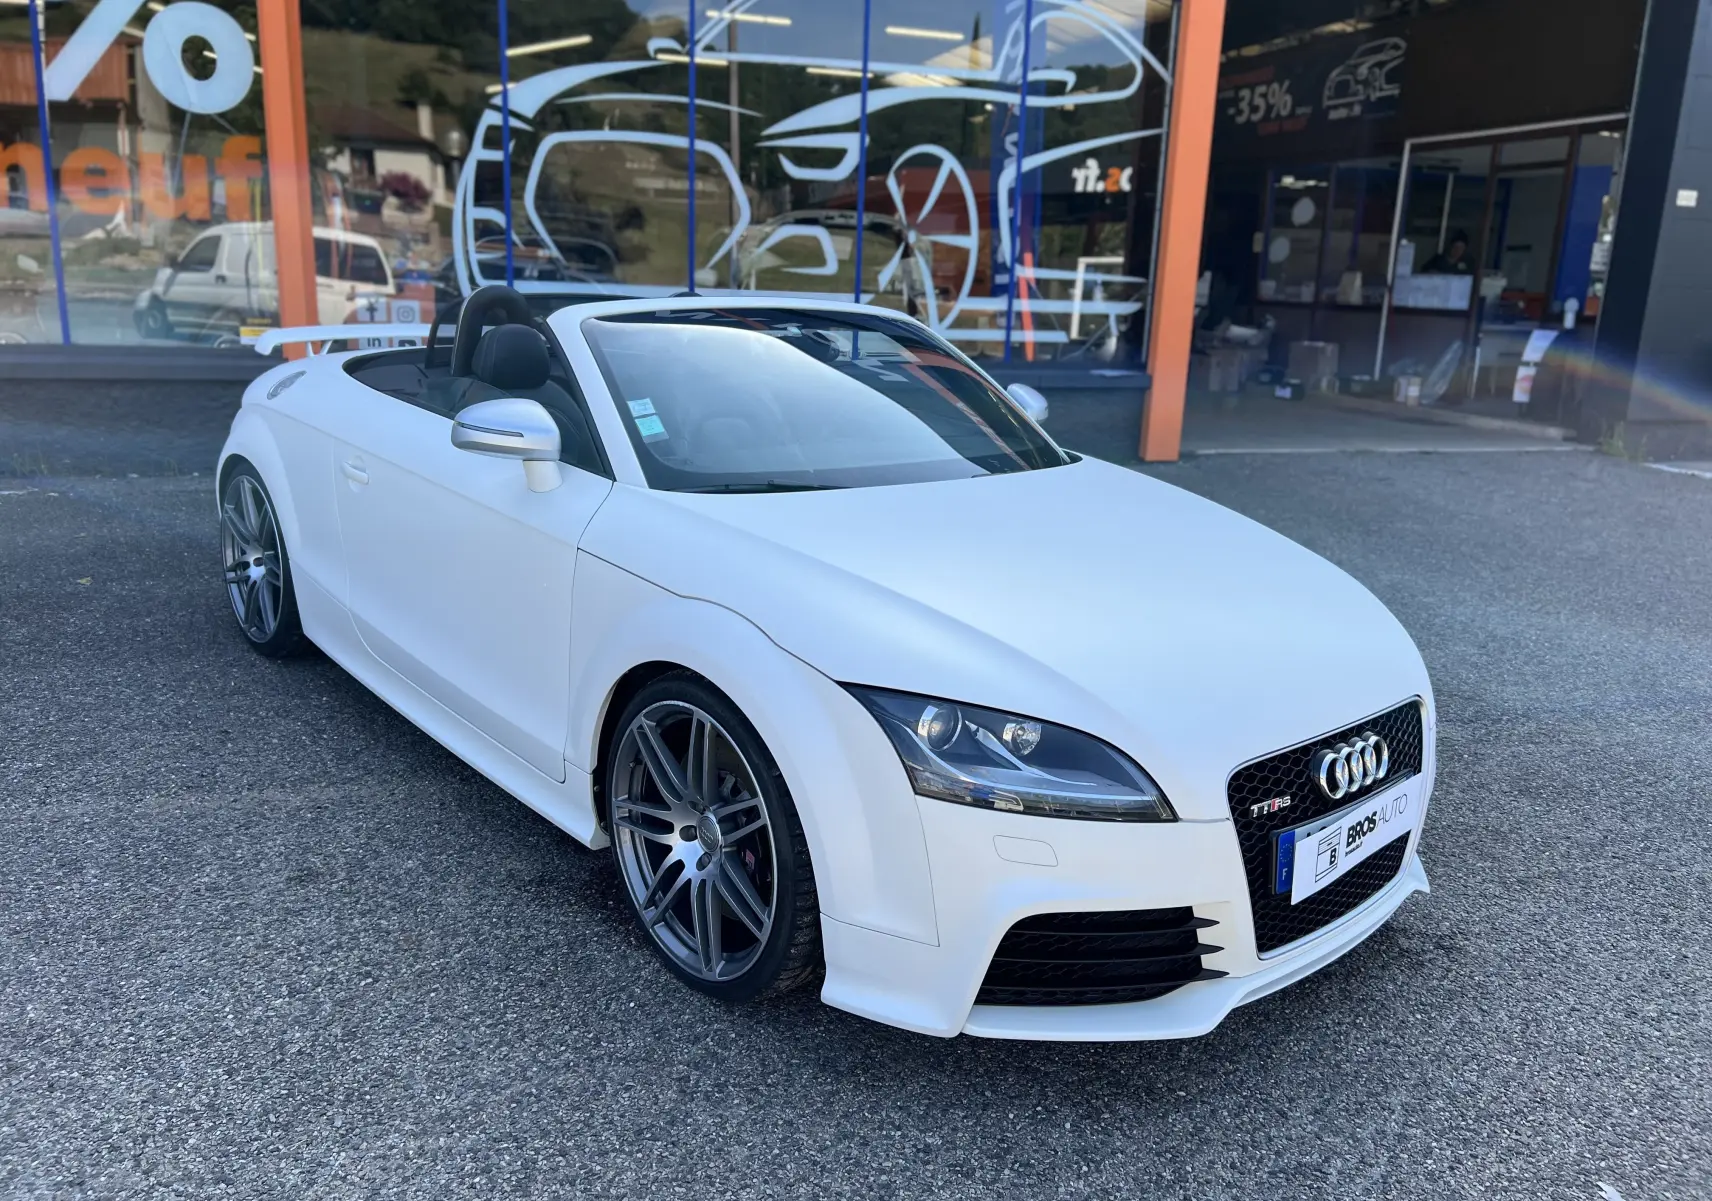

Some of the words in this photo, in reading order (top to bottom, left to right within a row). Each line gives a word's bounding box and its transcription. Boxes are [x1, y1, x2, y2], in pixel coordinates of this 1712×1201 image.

[1226, 79, 1293, 124] -35%
[0, 136, 262, 220] neuf
[1346, 811, 1377, 849] BROS
[1376, 793, 1408, 829] AUTO
[1282, 868, 1288, 880] F
[1329, 847, 1337, 866] B
